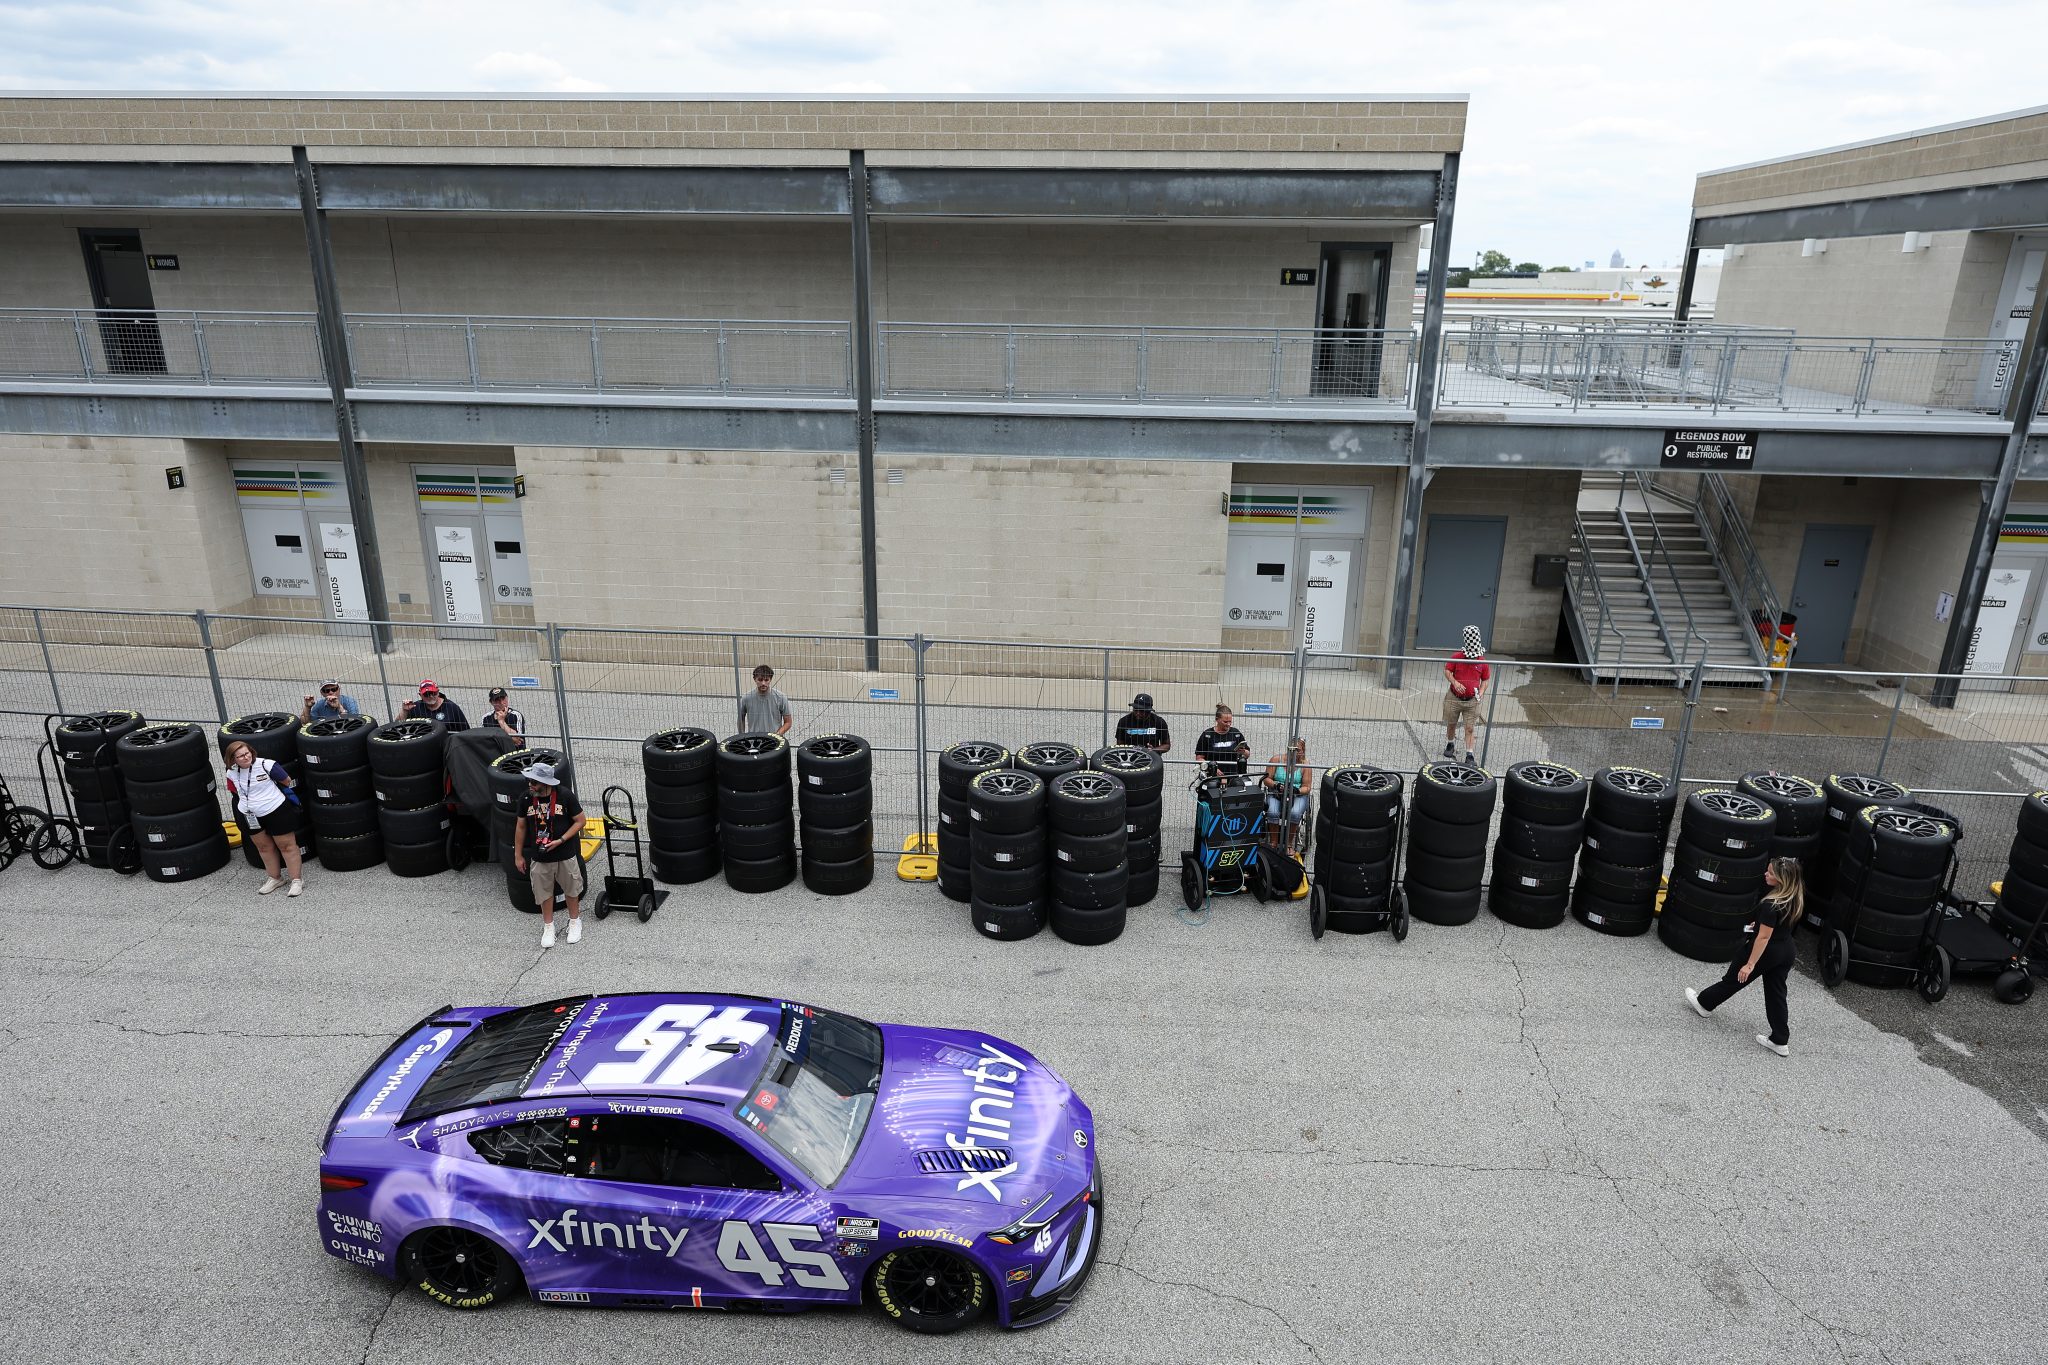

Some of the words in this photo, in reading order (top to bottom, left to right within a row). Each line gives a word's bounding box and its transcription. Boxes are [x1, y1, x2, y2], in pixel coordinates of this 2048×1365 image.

[156, 258, 176, 266] WOMEN
[1675, 432, 1720, 440] LEGENDS
[1722, 432, 1746, 442] ROW
[1686, 451, 1728, 459] RESTROOMS
[330, 576, 344, 618] LEGENDS
[444, 580, 457, 622] LEGENDS
[1304, 606, 1316, 650] LEGENDS
[1313, 640, 1341, 650] ROW
[1964, 626, 1982, 671] LEGENDS
[1218, 850, 1244, 866] 97
[548, 1002, 586, 1041] TOYOTA
[582, 1002, 609, 1029] xfinity
[556, 1029, 592, 1068] Imagine
[578, 1004, 770, 1086] 45
[786, 1018, 804, 1054] REDDICK
[359, 1044, 434, 1120] SupplyHouse
[518, 1039, 556, 1095] RACING
[540, 1070, 566, 1096] That
[620, 1104, 647, 1113] TYLER
[648, 1106, 684, 1115] REDDICK
[946, 1042, 1028, 1203] xfinity
[328, 1210, 382, 1235] CHUMBA
[334, 1222, 380, 1242] CASINO
[528, 1208, 690, 1258] xfinity
[898, 1228, 974, 1248] GOODYEAR
[1034, 1222, 1052, 1254] 45
[332, 1240, 385, 1262] OUTLAW
[346, 1253, 376, 1268] LIGHT
[716, 1220, 850, 1291] 45
[420, 1281, 494, 1308] GOODYEAR
[540, 1292, 574, 1301] Mobil
[876, 1252, 902, 1318] GOODYEAR
[971, 1272, 982, 1307] EAGLE
